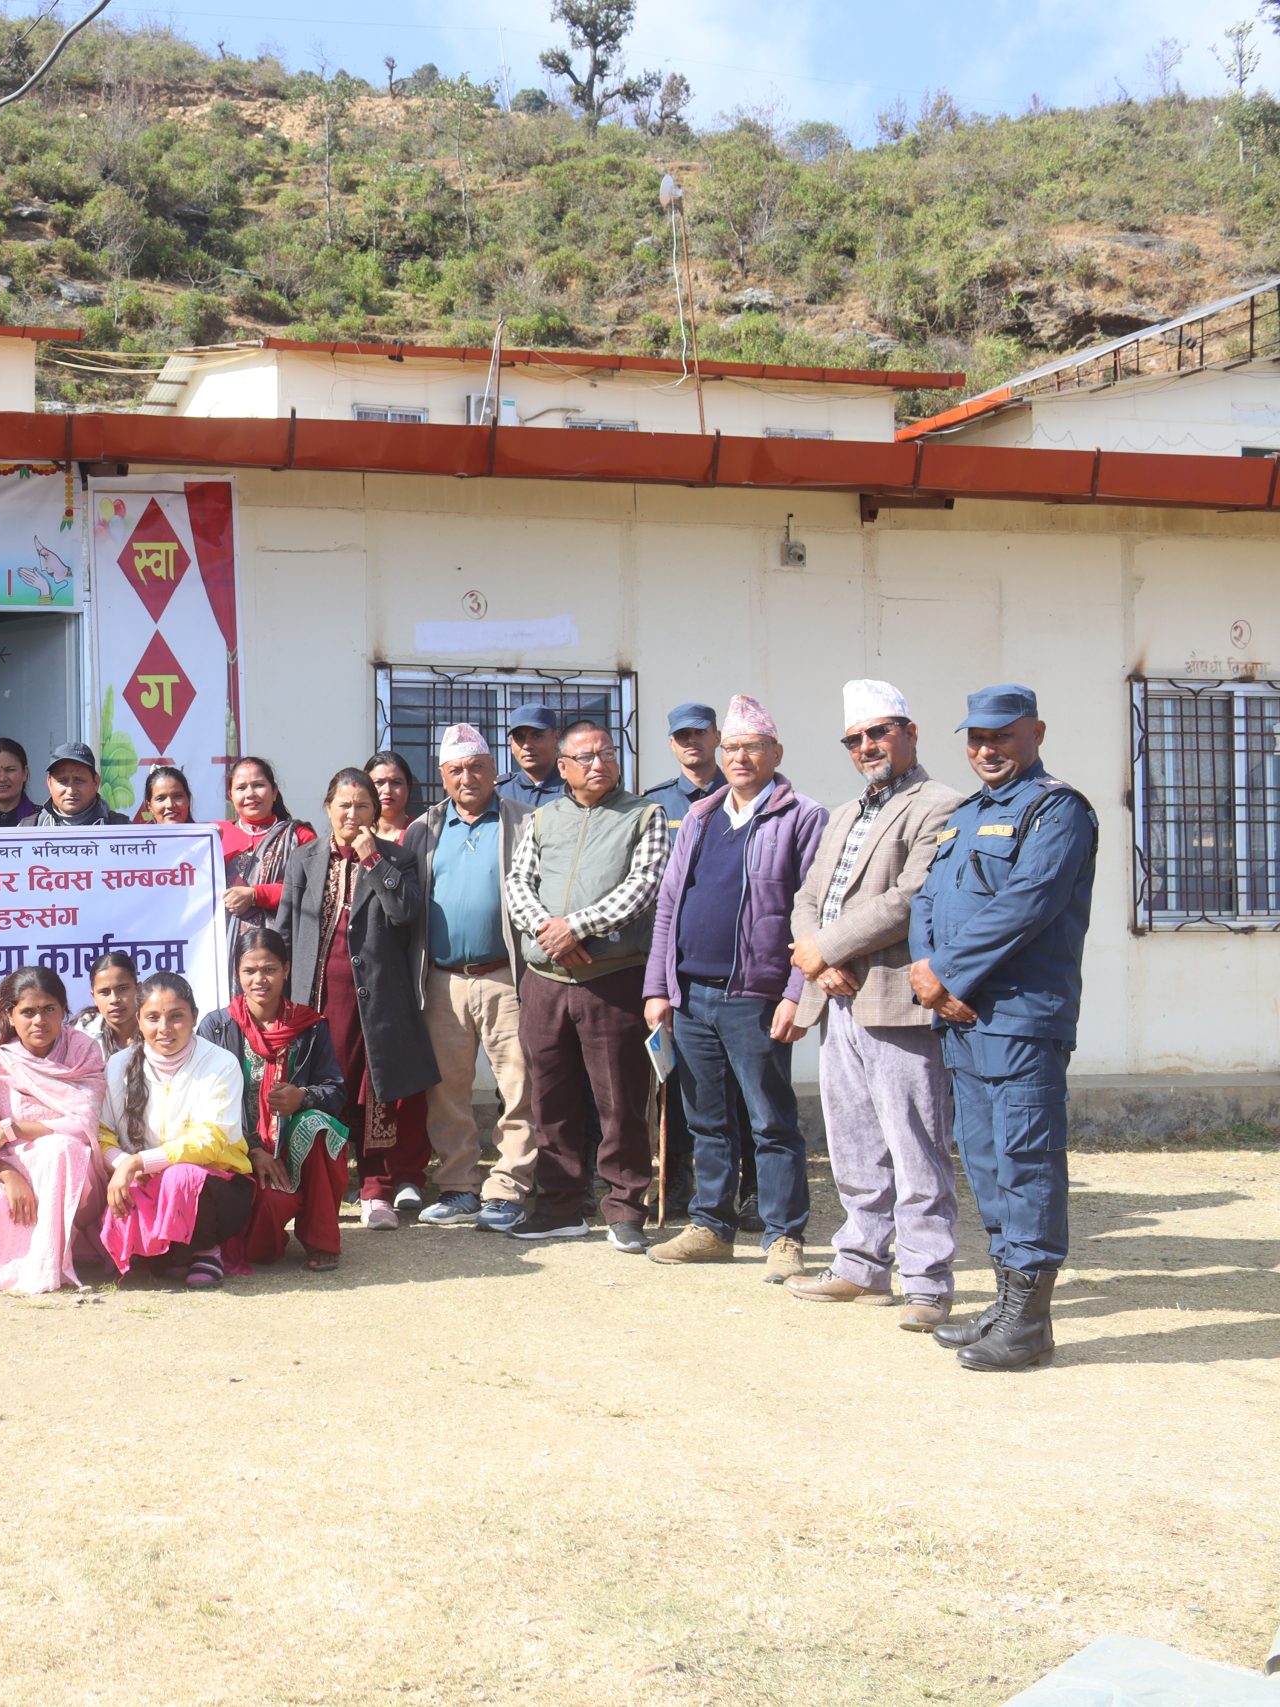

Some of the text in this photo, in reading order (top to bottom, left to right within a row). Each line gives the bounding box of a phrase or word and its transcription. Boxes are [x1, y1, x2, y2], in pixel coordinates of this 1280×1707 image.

[132, 542, 179, 589] स्वा
[136, 674, 180, 717] ग
[31, 841, 99, 858] भविष्यको
[110, 839, 157, 856] थालनी
[28, 865, 93, 891] दिवस
[101, 862, 196, 891] सम्बन्धी
